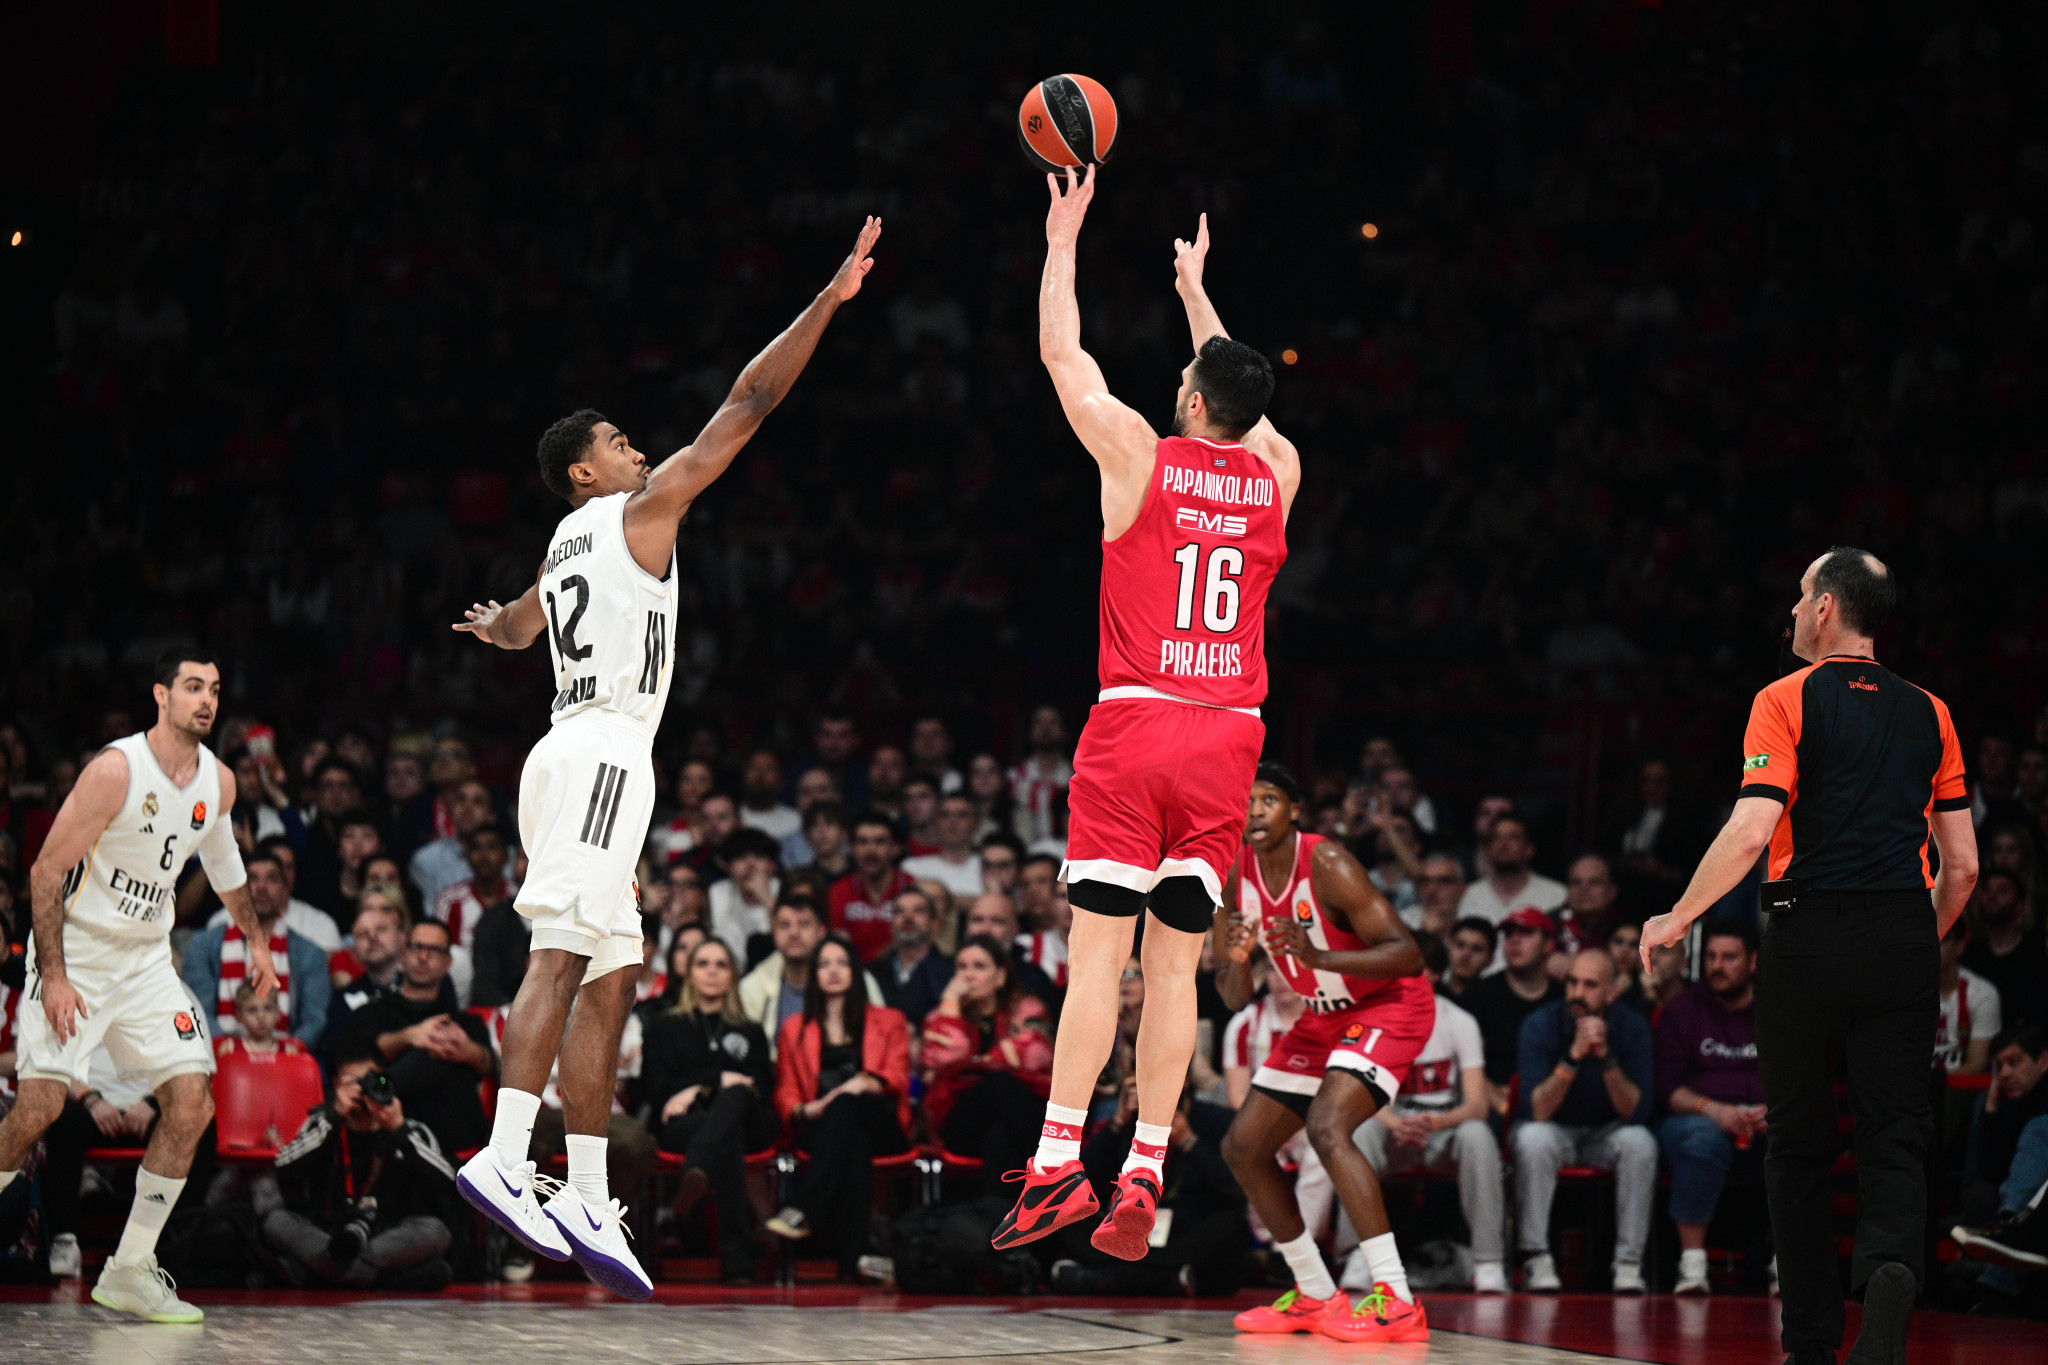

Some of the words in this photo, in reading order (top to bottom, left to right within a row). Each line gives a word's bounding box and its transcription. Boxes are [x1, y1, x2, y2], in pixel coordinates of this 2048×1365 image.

[1163, 465, 1273, 507] PAPANIKOLAOU
[1176, 507, 1248, 535] FMS
[1174, 542, 1244, 633] 16
[546, 574, 593, 672] 12
[1159, 640, 1242, 677] PIRAEUS
[1848, 681, 1879, 691] SPALDING
[159, 834, 177, 870] 6
[117, 897, 141, 917] FLY
[1363, 1027, 1383, 1054] 1
